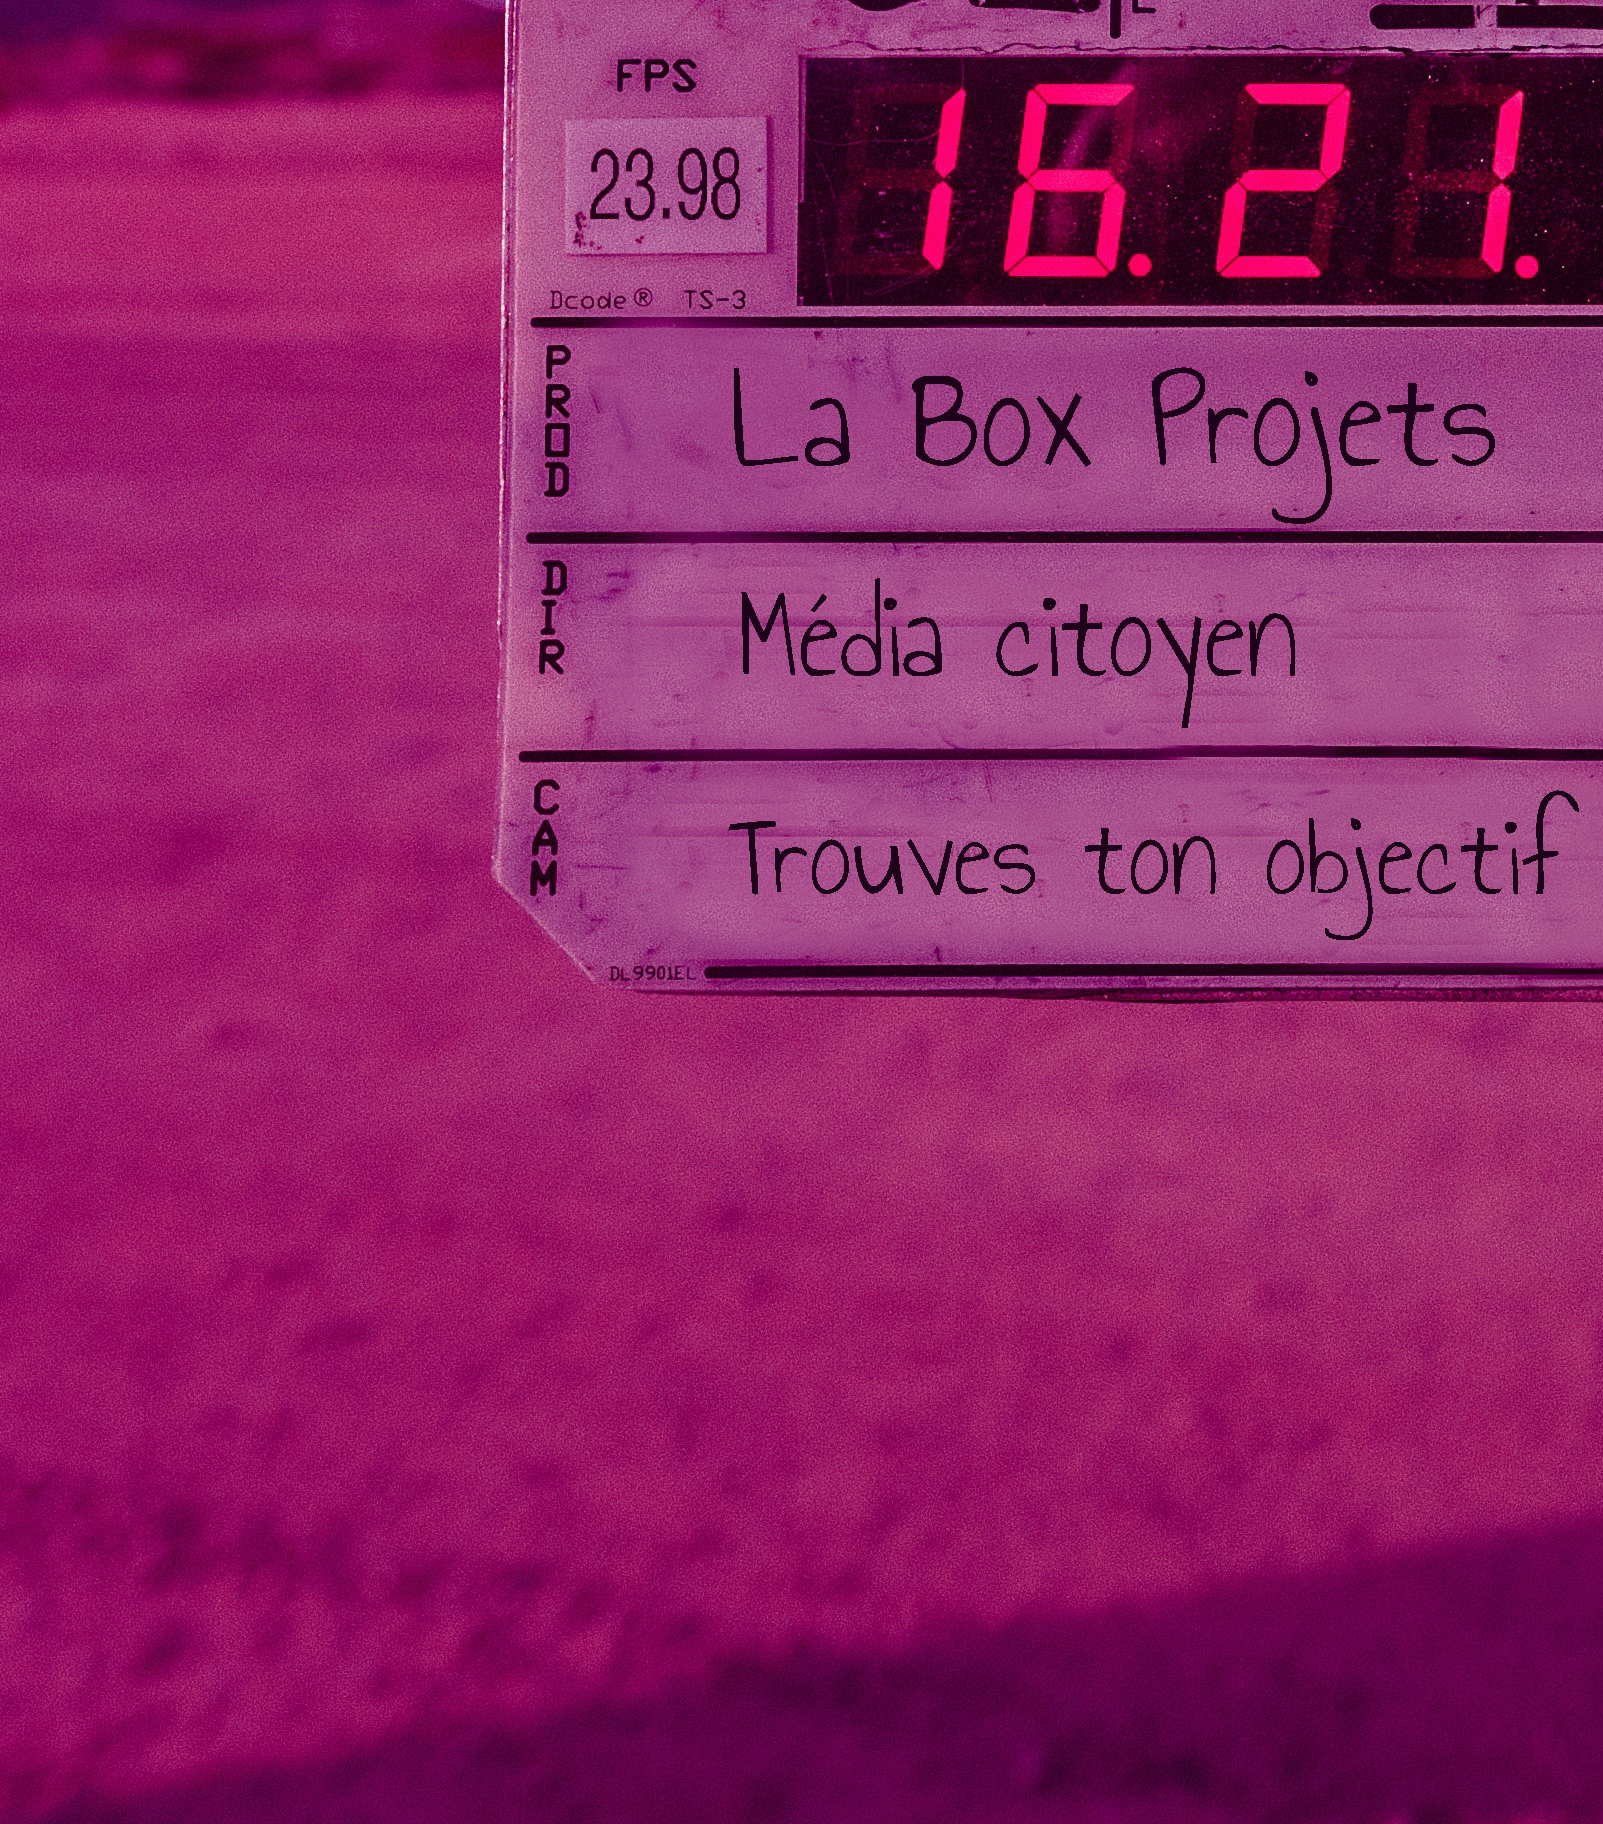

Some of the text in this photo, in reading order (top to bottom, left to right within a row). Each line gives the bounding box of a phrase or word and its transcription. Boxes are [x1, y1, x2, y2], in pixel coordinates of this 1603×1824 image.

[616, 58, 697, 93] FPS
[589, 146, 741, 221] 23.98
[684, 289, 746, 310] TS-3
[544, 344, 571, 498] PROD
[733, 366, 1496, 525] La Box Projets
[538, 559, 568, 675] DIR
[740, 577, 1296, 729] Média citoyen
[529, 779, 560, 896] CAM
[728, 820, 1036, 896] Trouves
[1084, 827, 1217, 895] ton
[1266, 789, 1580, 942] objectif
